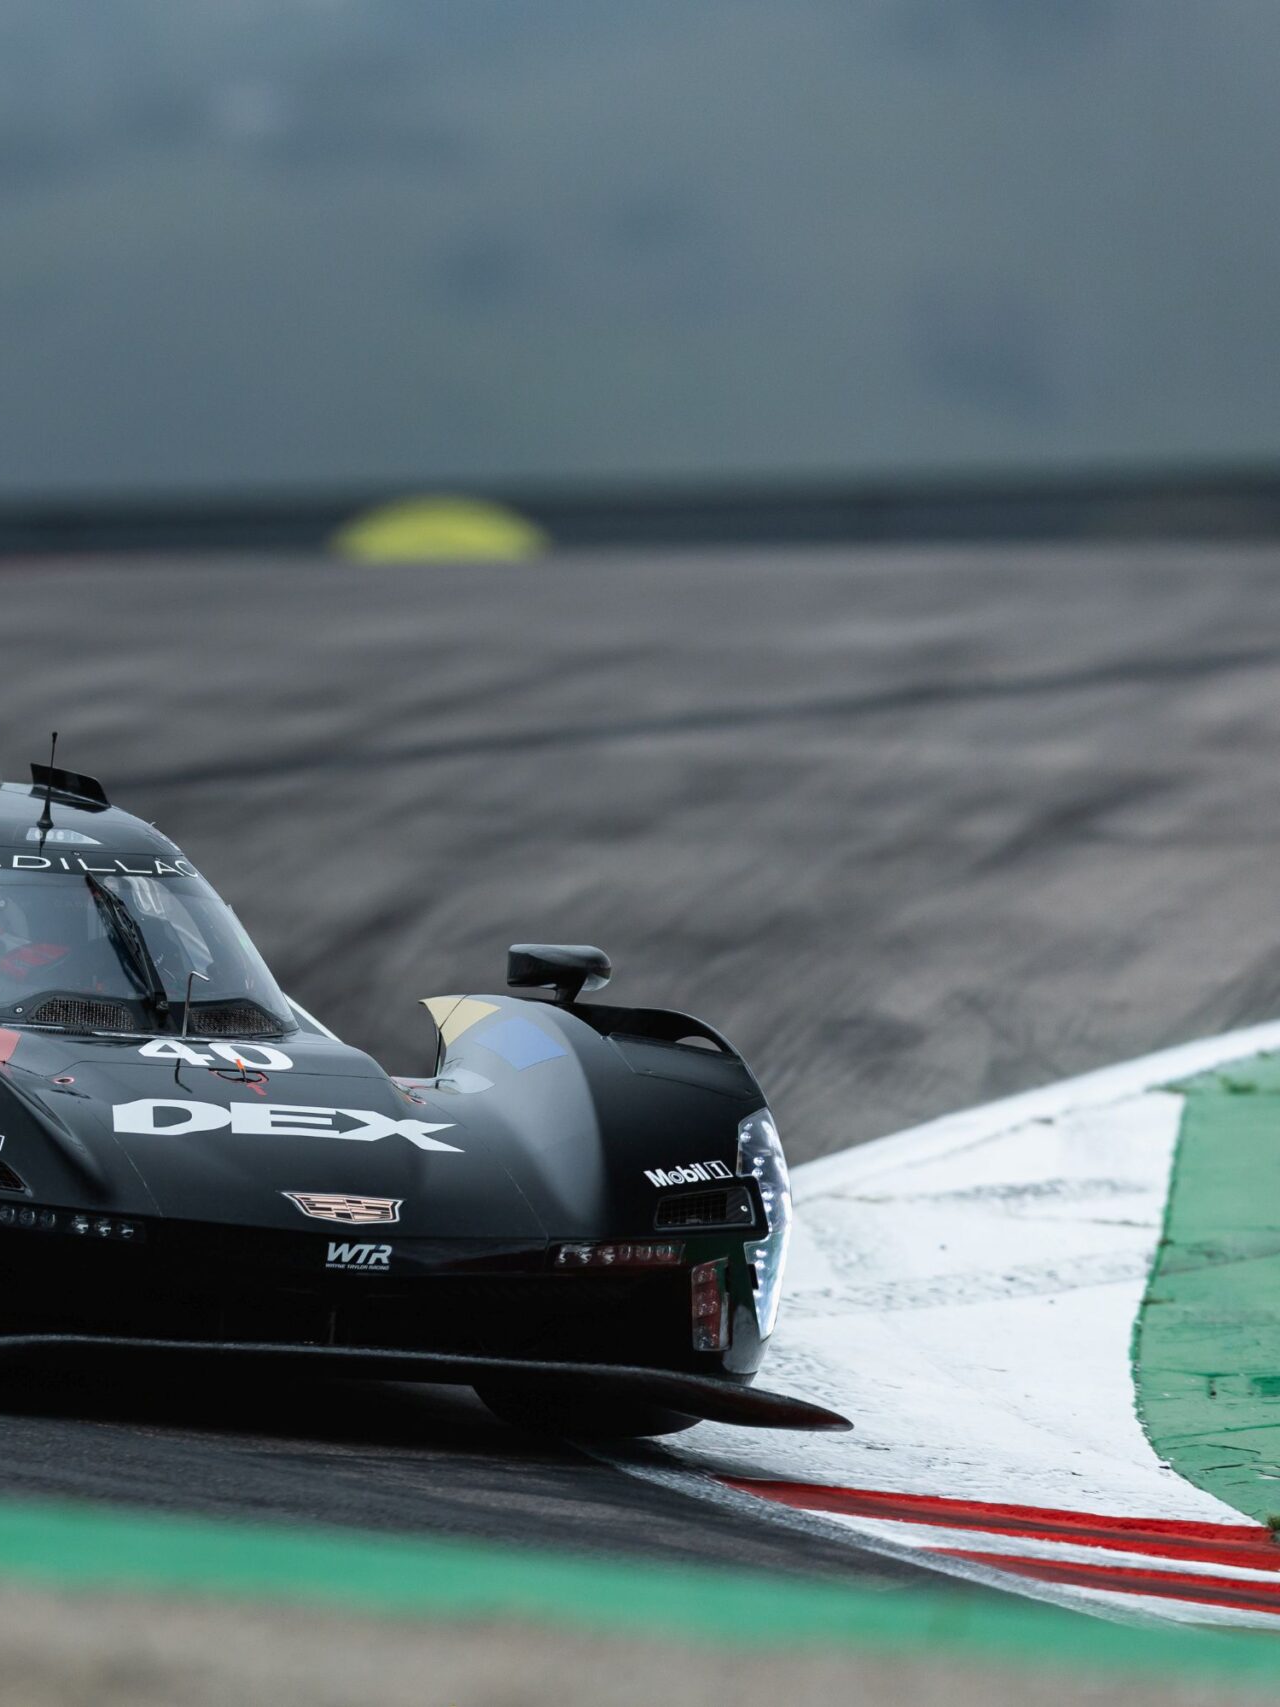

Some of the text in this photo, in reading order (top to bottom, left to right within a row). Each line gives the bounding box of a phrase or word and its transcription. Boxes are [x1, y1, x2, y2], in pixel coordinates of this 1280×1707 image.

[138, 1039, 293, 1071] 40
[113, 1098, 466, 1153] DEX
[643, 1162, 712, 1188] Mobil
[327, 1241, 393, 1265] WTR
